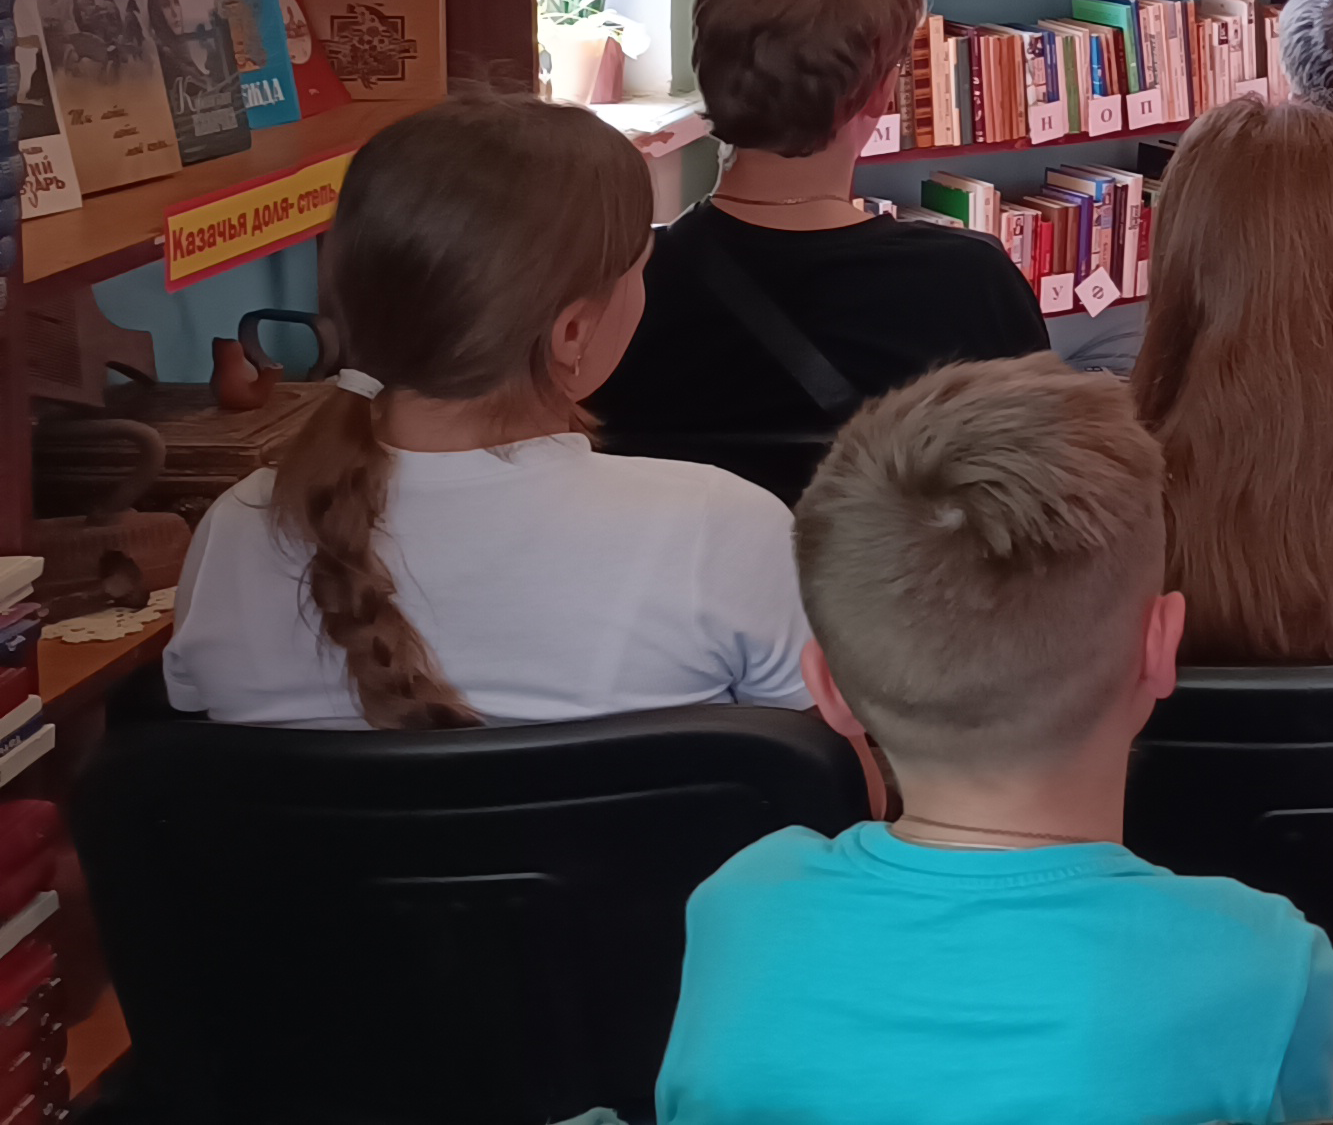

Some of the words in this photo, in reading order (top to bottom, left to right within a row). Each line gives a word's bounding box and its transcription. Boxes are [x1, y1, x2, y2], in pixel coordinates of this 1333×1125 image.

[1100, 107, 1112, 123] О
[1140, 101, 1154, 115] П
[1040, 115, 1054, 131] Н
[172, 203, 248, 263] Казачья
[252, 189, 296, 239] доля-
[1052, 285, 1064, 301] У
[1090, 285, 1104, 301] Ф
